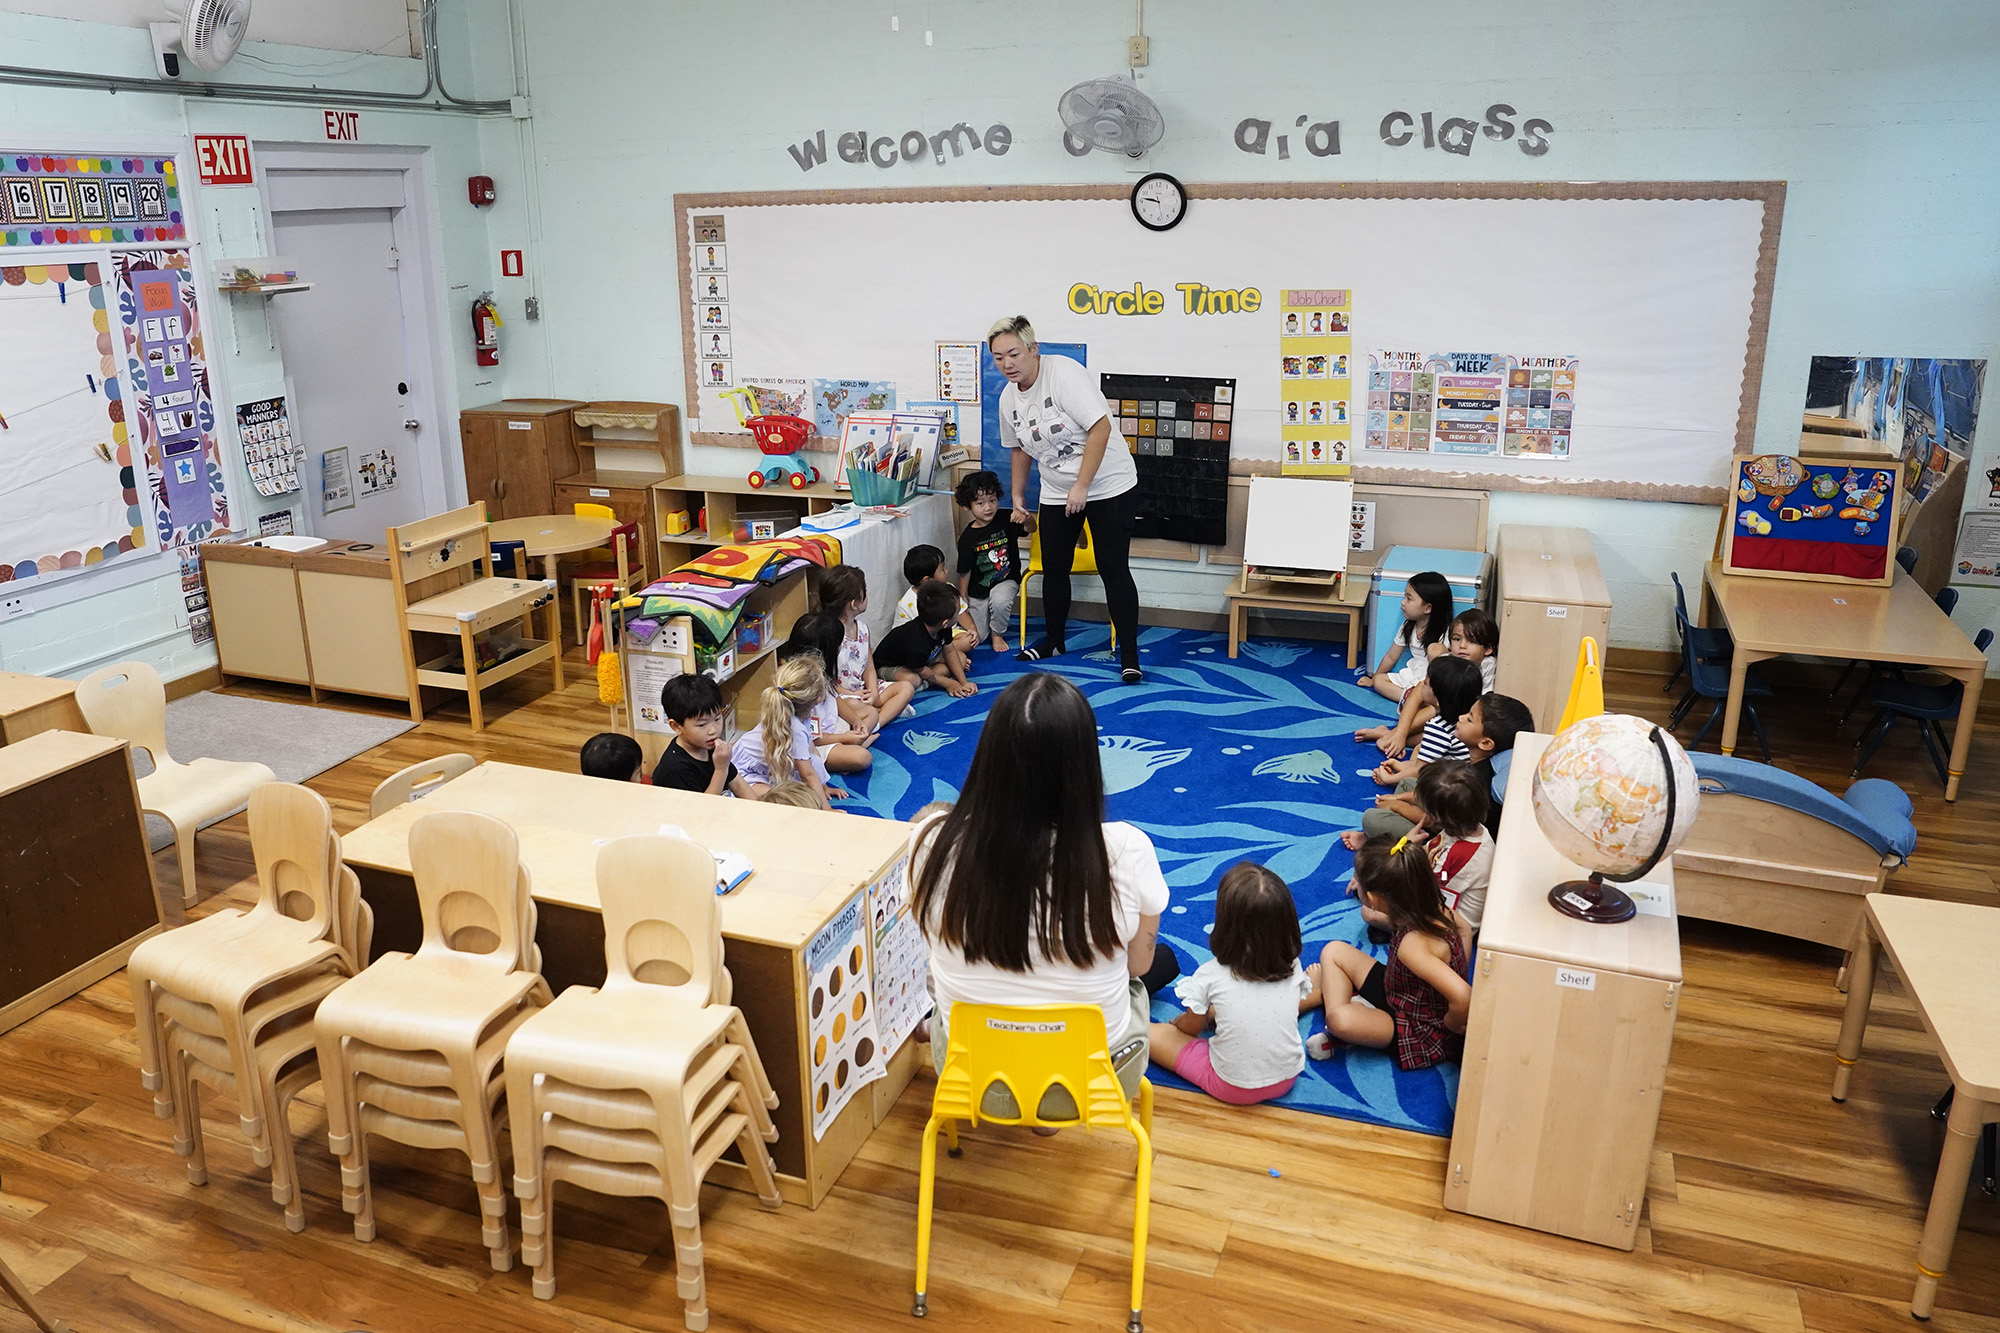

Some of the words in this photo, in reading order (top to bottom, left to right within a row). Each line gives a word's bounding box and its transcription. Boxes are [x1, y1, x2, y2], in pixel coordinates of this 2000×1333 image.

[324, 111, 359, 140] EXIT
[197, 139, 248, 176] EXIT
[14, 185, 30, 203] 16
[50, 185, 62, 203] 17
[83, 186, 98, 203] 18
[114, 186, 128, 203] 19
[141, 186, 159, 202] 20
[146, 286, 168, 296] Focus
[149, 297, 168, 308] Wall
[1068, 282, 1164, 315] Circle
[1175, 282, 1262, 315] Time
[1292, 291, 1312, 306] Job
[1314, 290, 1342, 306] Chart
[146, 319, 155, 339] F
[168, 318, 177, 336] f
[1384, 351, 1421, 360] MONTHS
[1398, 361, 1422, 370] YEAR
[1455, 360, 1489, 373] WEEK
[1521, 357, 1567, 368] WEATHER
[162, 395, 169, 406] 4
[251, 402, 271, 413] GOOD
[246, 410, 279, 424] MANNERS
[1127, 422, 1132, 430] 1
[1145, 423, 1150, 431] 2
[1163, 424, 1169, 432] 3
[1199, 426, 1205, 434] 5
[1217, 428, 1223, 436] 6
[1144, 442, 1150, 450] 9
[1160, 443, 1170, 451] 10
[941, 450, 965, 461] Bonjour
[989, 537, 1008, 548] MARIO
[811, 929, 831, 960] MOON
[832, 904, 856, 938] PHASES
[1560, 972, 1591, 985] Shelf
[988, 1019, 1036, 1032] Teacher's
[1038, 1023, 1064, 1032] Chair
